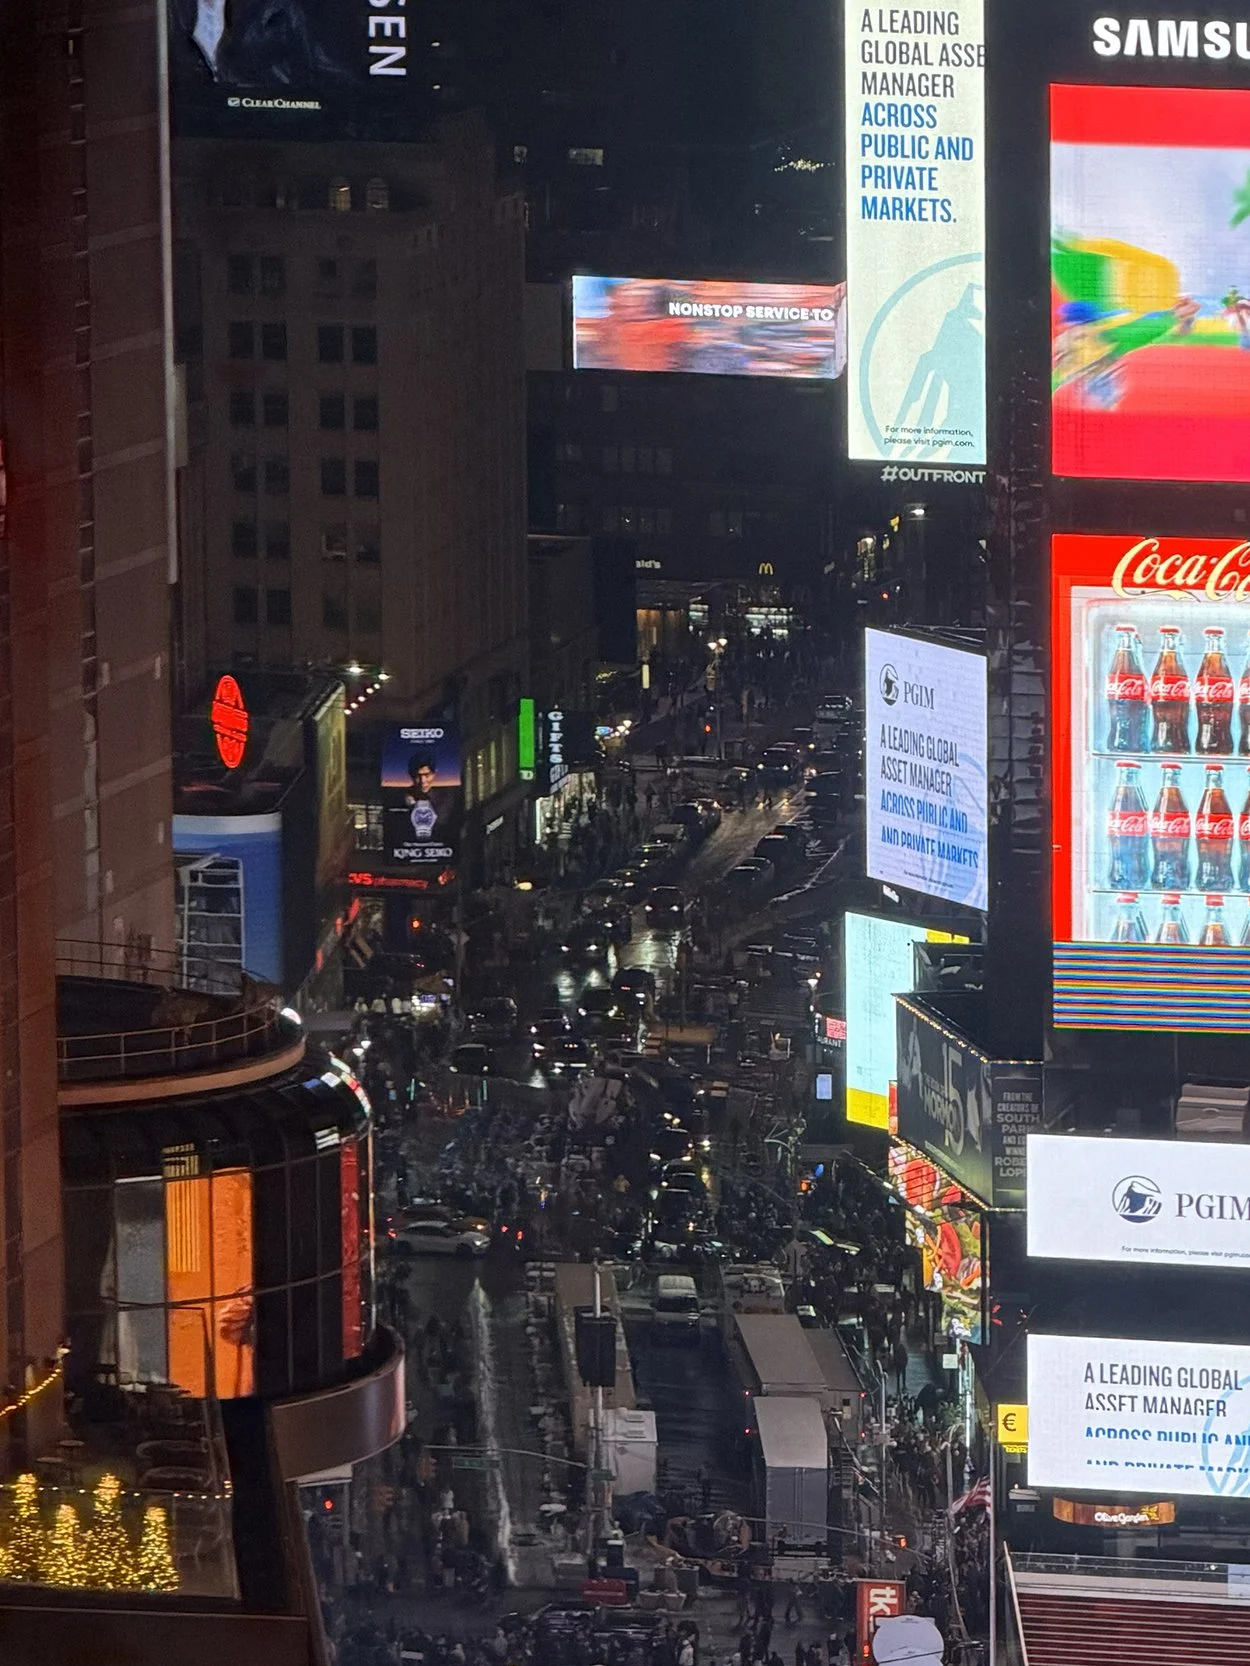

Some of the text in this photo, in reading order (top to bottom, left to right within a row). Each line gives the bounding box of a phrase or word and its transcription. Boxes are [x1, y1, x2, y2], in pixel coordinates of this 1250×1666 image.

[861, 9, 960, 36] A LEADING
[861, 39, 934, 67] GLOBAL
[861, 71, 956, 99] MANAGER
[861, 102, 938, 129] ACROSS
[861, 133, 974, 161] PUBLIC AND
[861, 164, 939, 191] PRIVATE
[861, 195, 957, 223] MARKETS.
[668, 302, 834, 321] NONSTOP SERVICE TO
[883, 437, 912, 446] please
[914, 438, 931, 446] visit
[885, 425, 974, 437] For more information,
[903, 680, 935, 710] PGIM
[400, 728, 445, 739] SEIKO
[547, 711, 564, 763] GIFTS
[880, 723, 960, 768] A LEADING GLOBAL
[880, 755, 952, 798] ASSET MANAGER
[393, 848, 453, 858] KING SEIKO
[996, 1113, 1040, 1123] SOUTH
[1084, 1362, 1243, 1391] A LEADING GLOBAL
